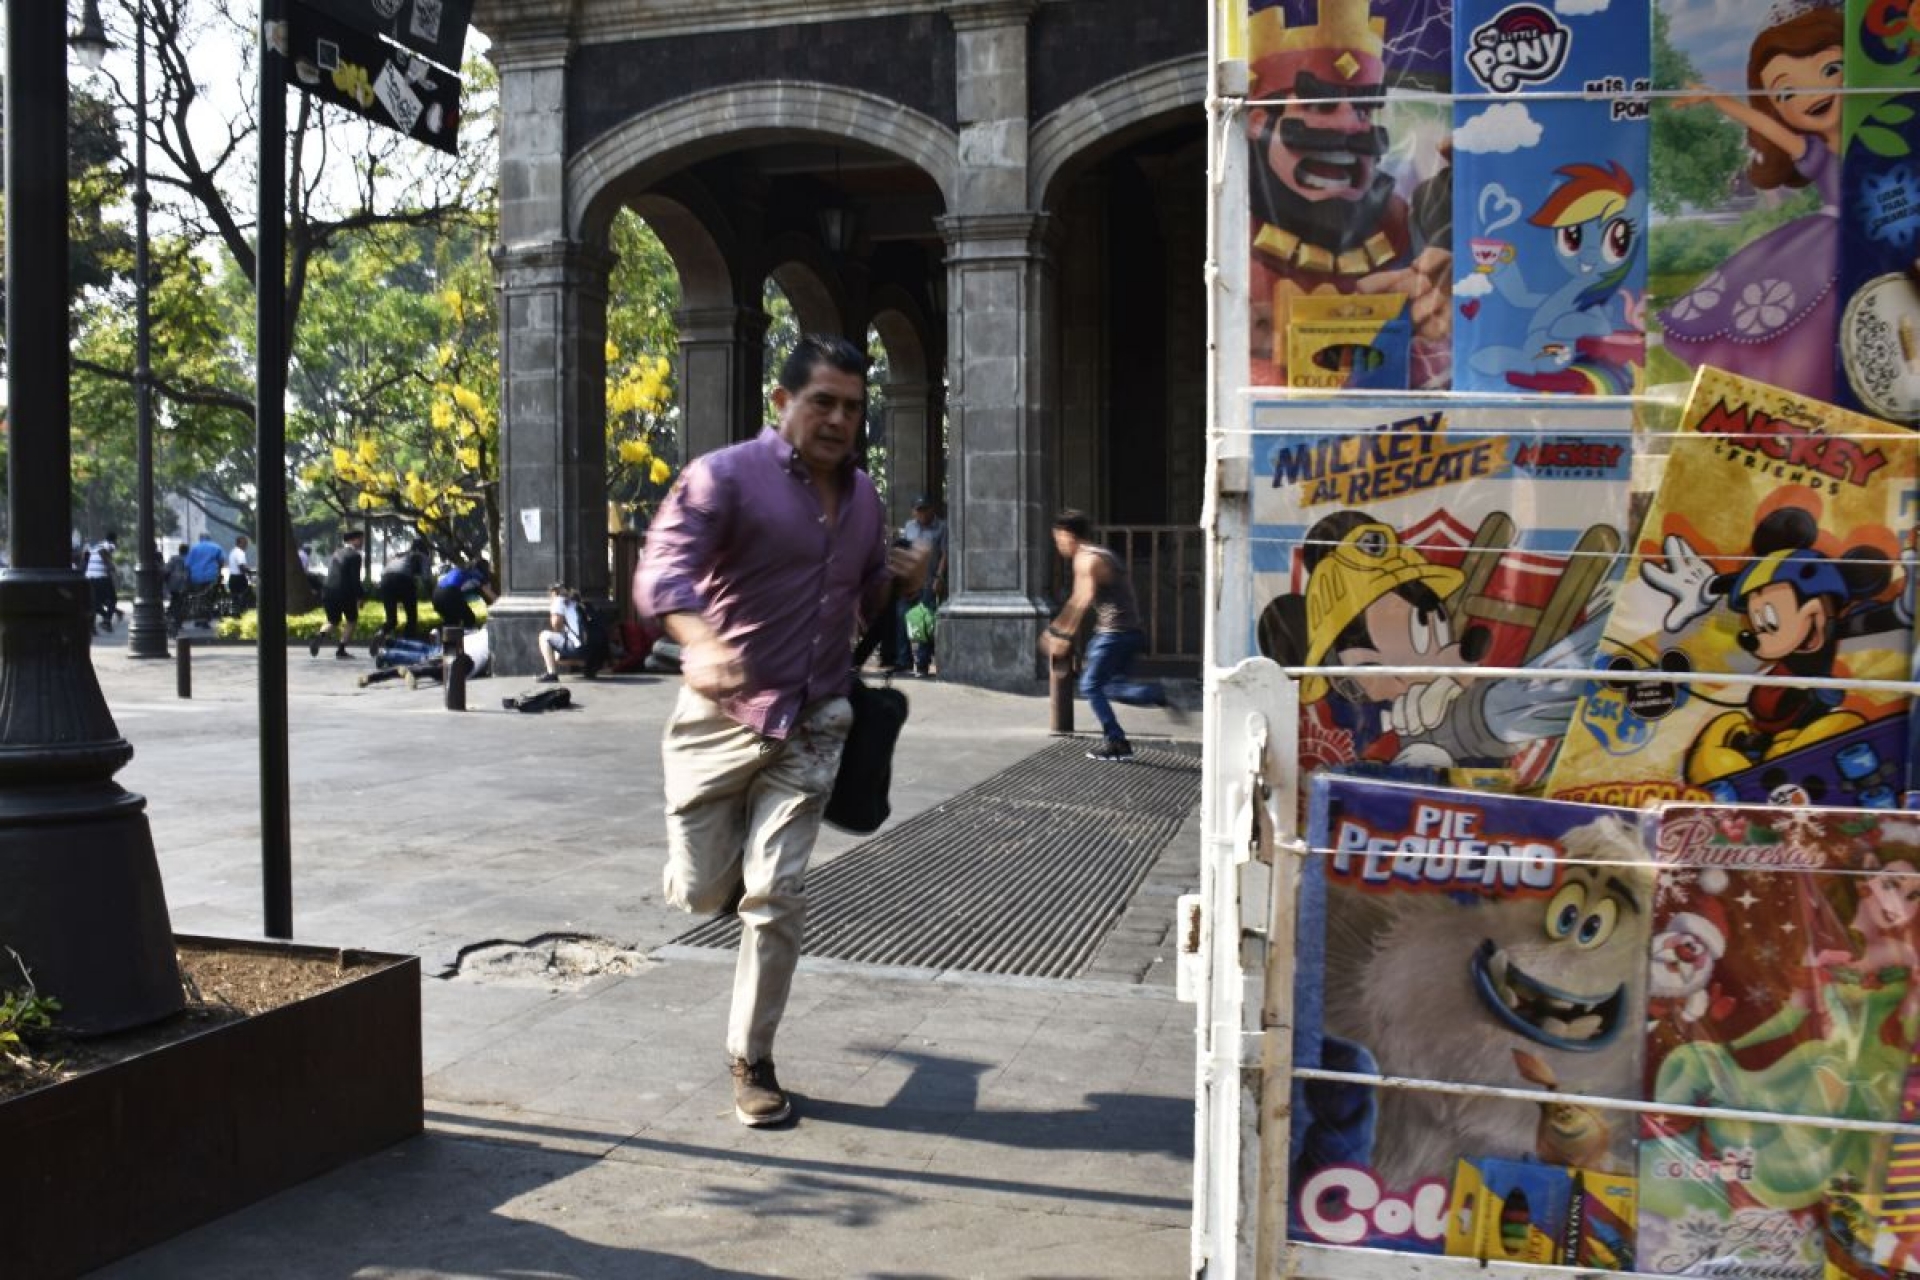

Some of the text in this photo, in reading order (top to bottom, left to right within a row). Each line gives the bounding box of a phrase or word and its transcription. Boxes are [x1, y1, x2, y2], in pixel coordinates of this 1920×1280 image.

[1471, 32, 1563, 88] PONY
[1272, 411, 1443, 488] MICKEY
[1695, 396, 1889, 488] MICKEY
[1311, 477, 1342, 504] AL
[1348, 443, 1492, 504] RESCATE
[1727, 447, 1841, 496] FRIENDS
[1415, 804, 1478, 839] PIE
